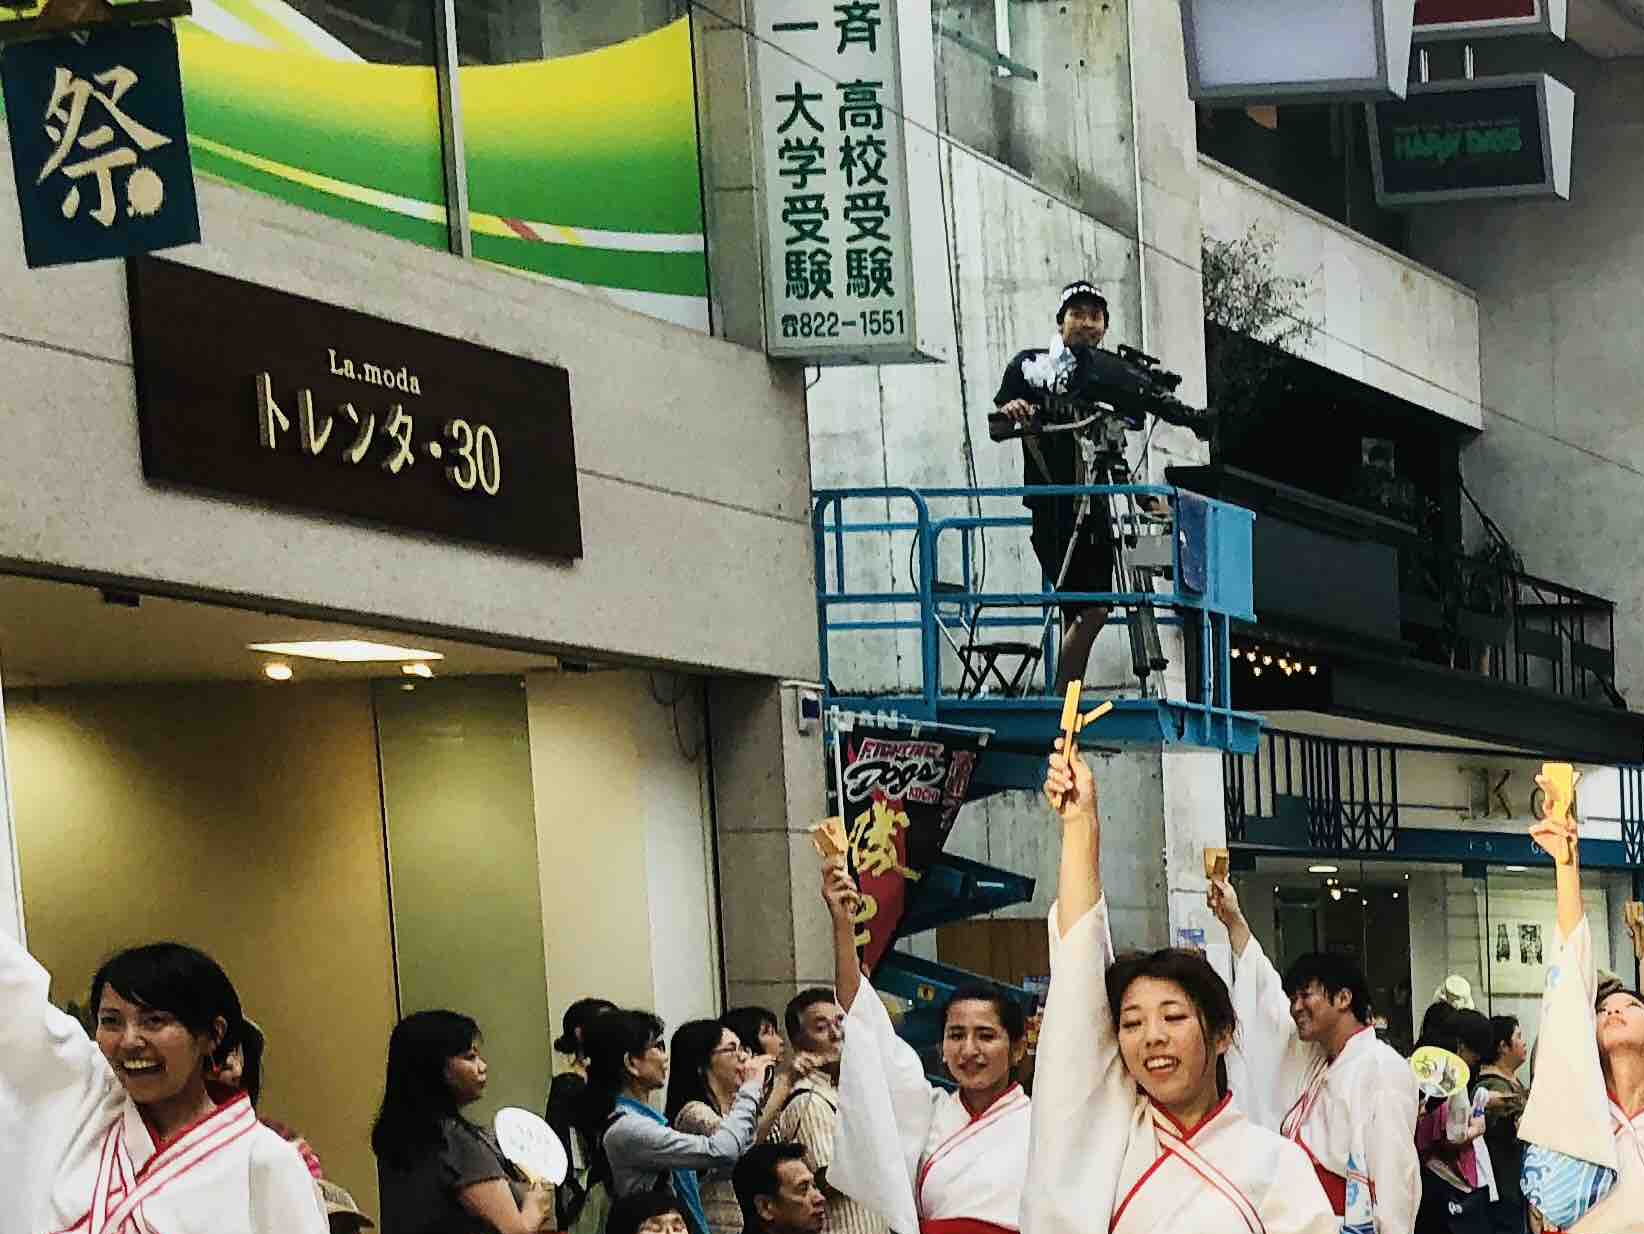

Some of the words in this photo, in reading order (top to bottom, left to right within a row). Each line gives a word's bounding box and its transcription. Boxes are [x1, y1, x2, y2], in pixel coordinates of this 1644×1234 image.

[35, 64, 173, 228] 祭
[775, 80, 834, 300] 大学受験
[834, 78, 896, 299] 高校受験
[327, 348, 421, 396] La.moda
[845, 758, 945, 803] Dogs
